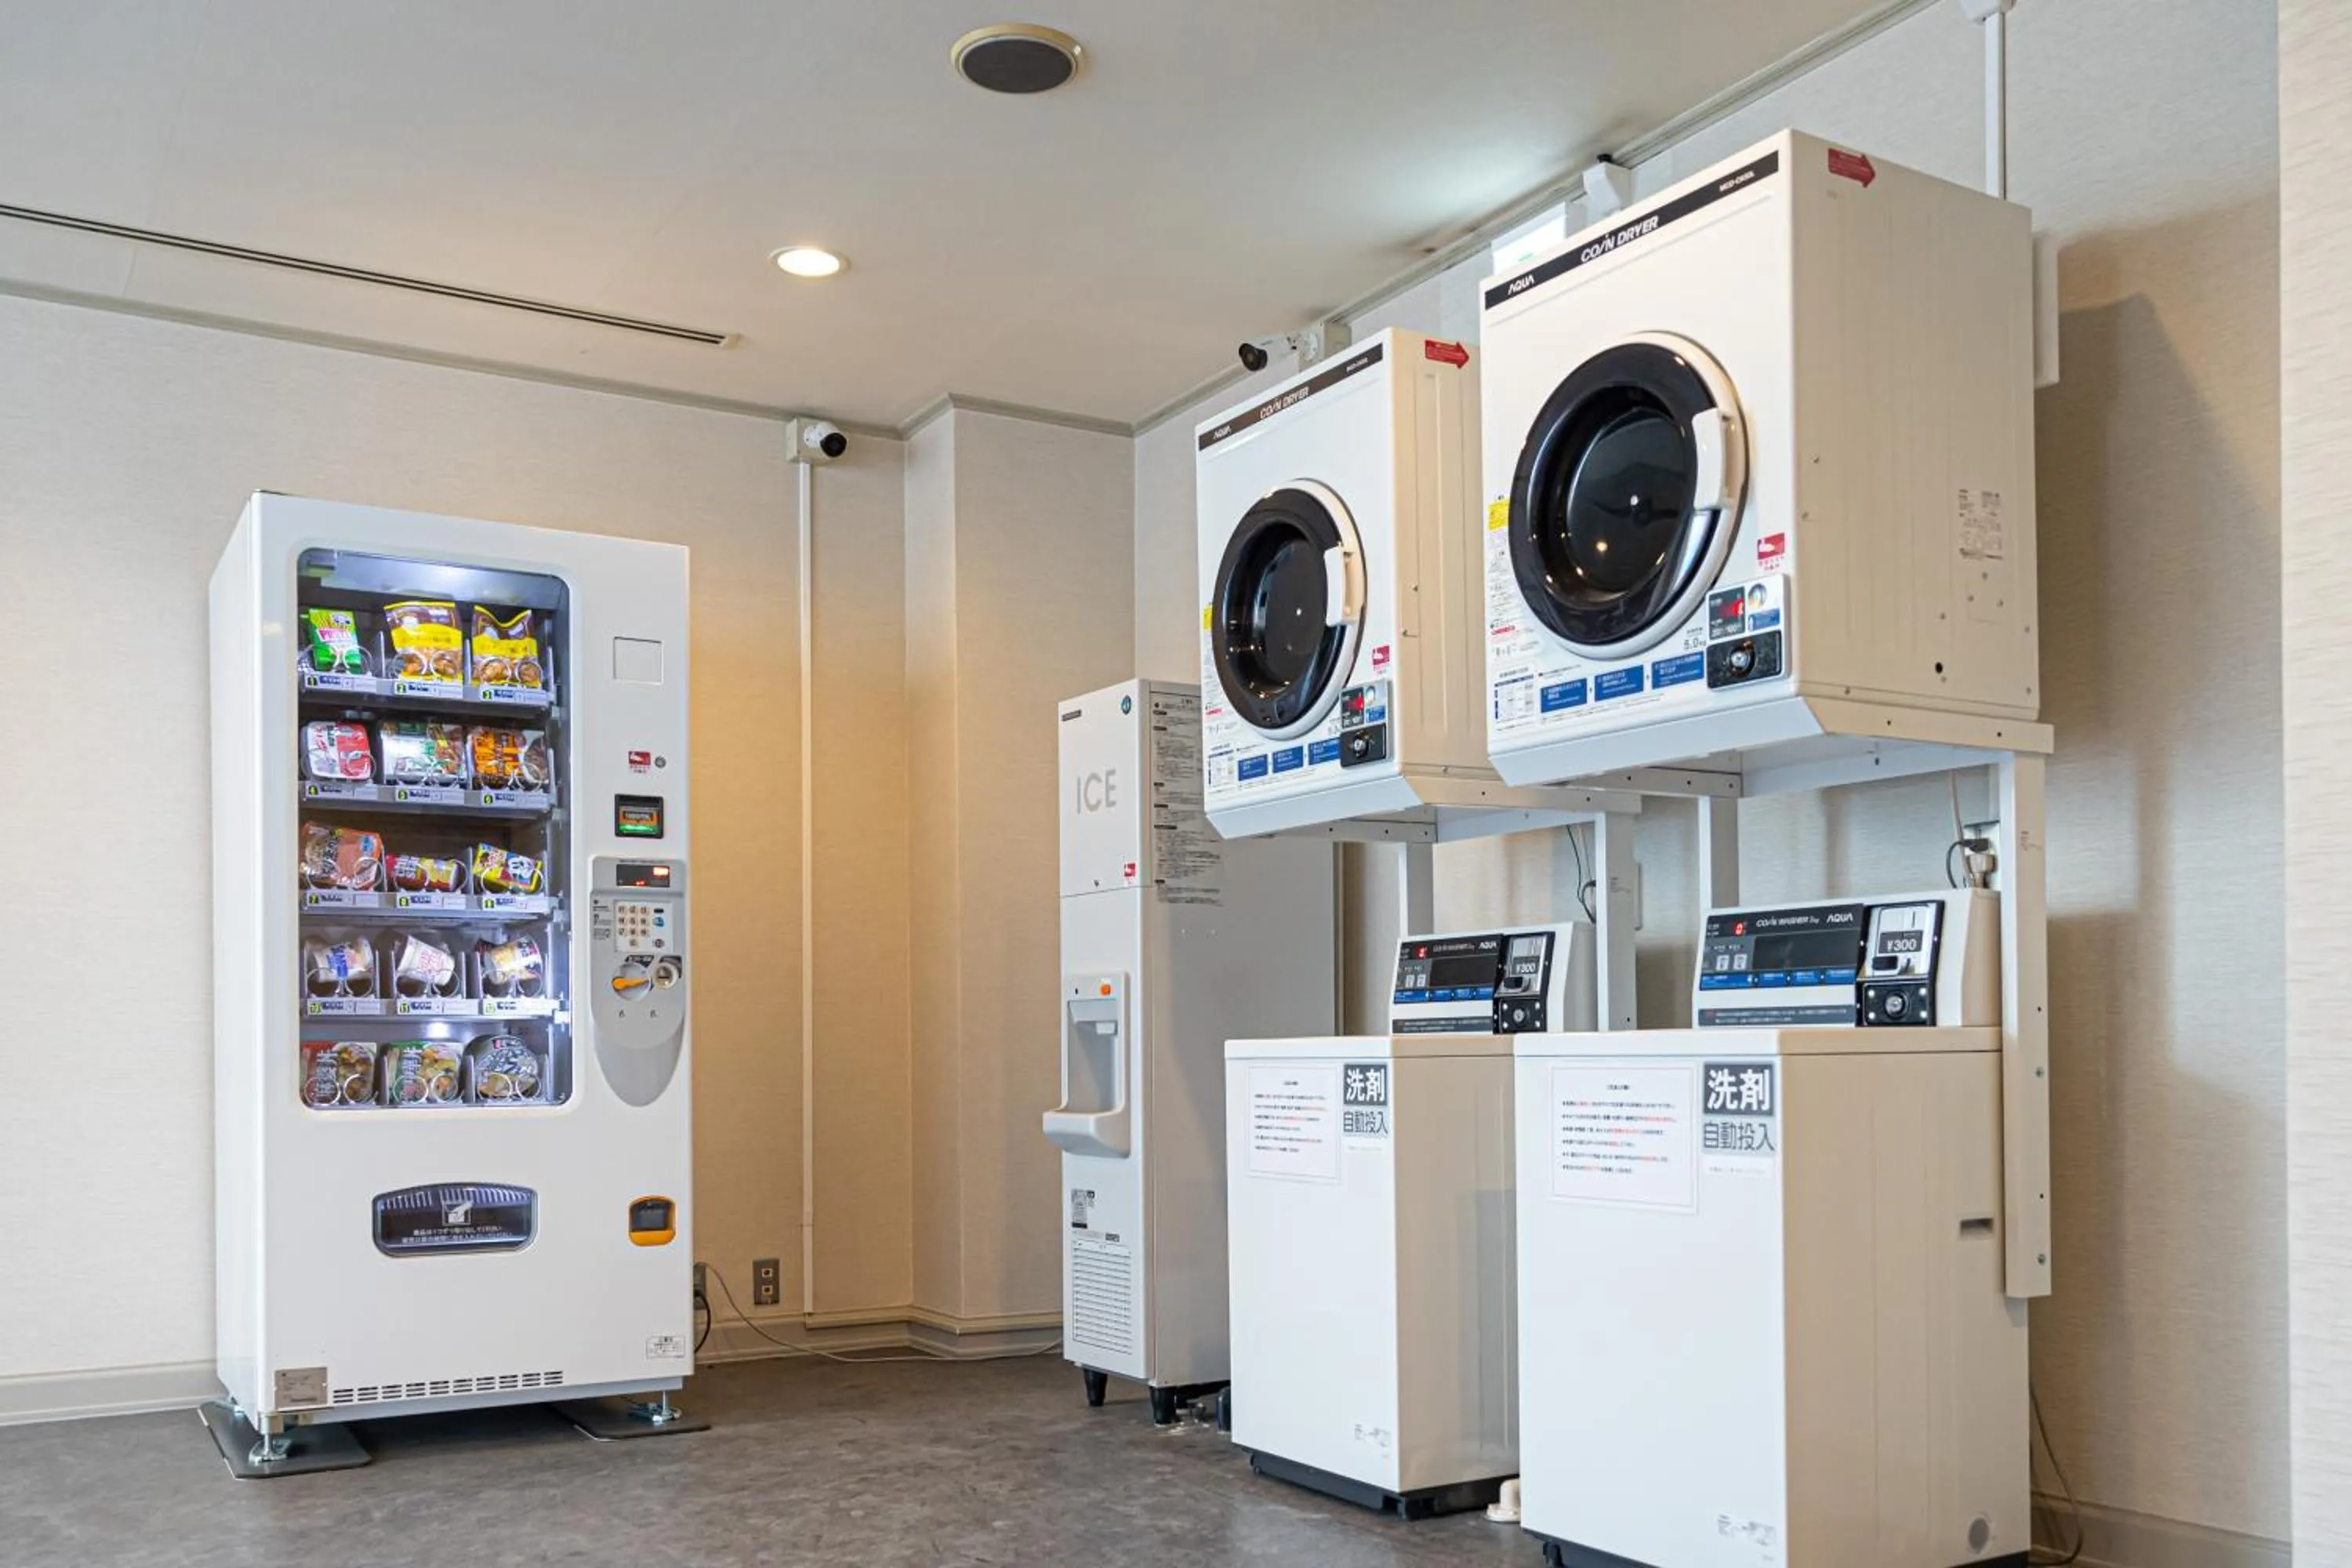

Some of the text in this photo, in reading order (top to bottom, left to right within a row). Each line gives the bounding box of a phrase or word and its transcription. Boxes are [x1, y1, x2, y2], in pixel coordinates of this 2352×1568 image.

[1617, 216, 1660, 245] DRYER
[1508, 274, 1534, 296] AQUA
[1282, 386, 1308, 408] DRYER
[1076, 768, 1116, 815] ICE
[1827, 912, 1854, 924] AQUA
[1887, 939, 1917, 952] ¥300
[1346, 1069, 1385, 1102] 洗剤
[1708, 1068, 1770, 1112] 洗剤
[1343, 1110, 1388, 1134] 自動投入
[1703, 1120, 1776, 1152] 自動投入
